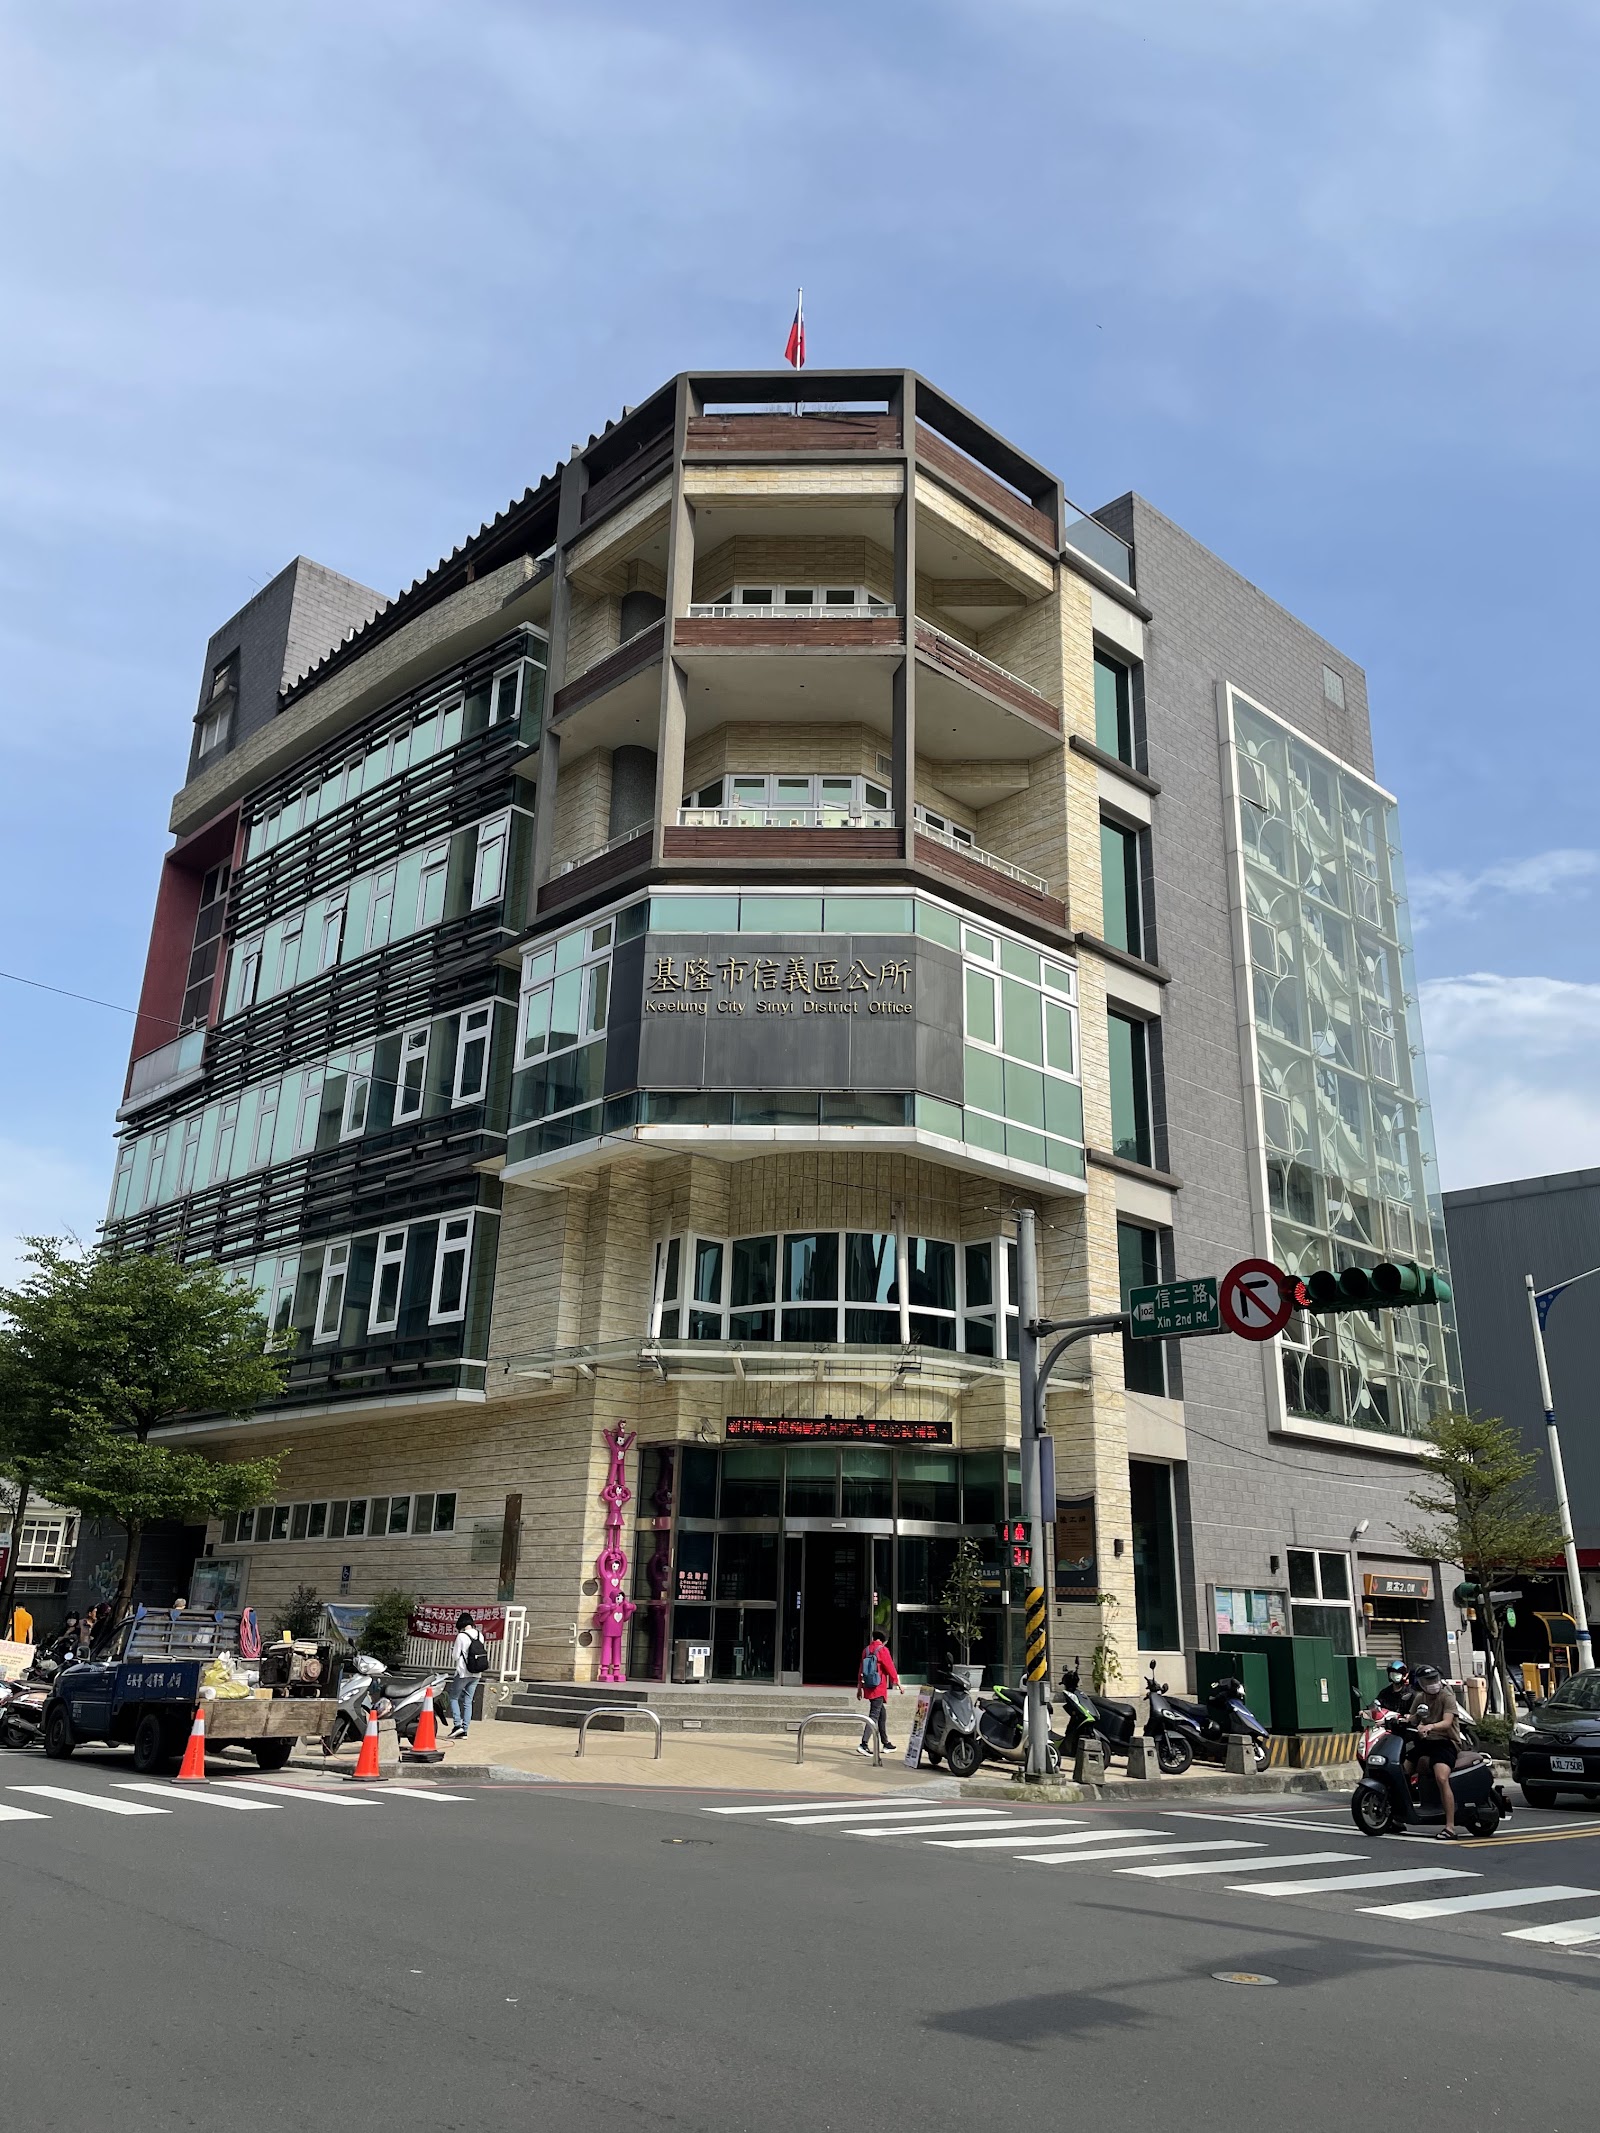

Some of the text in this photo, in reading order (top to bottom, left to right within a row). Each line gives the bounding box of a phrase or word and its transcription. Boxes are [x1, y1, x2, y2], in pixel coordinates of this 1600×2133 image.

[650, 956, 913, 994] 基隆市信義區公所
[645, 1000, 912, 1014] Keelung City Sinyi District Office
[1155, 1283, 1208, 1309] 信二路
[1141, 1307, 1154, 1316] 102
[1157, 1311, 1210, 1329] Xin 2nd Rd.
[1013, 1546, 1030, 1567] 31
